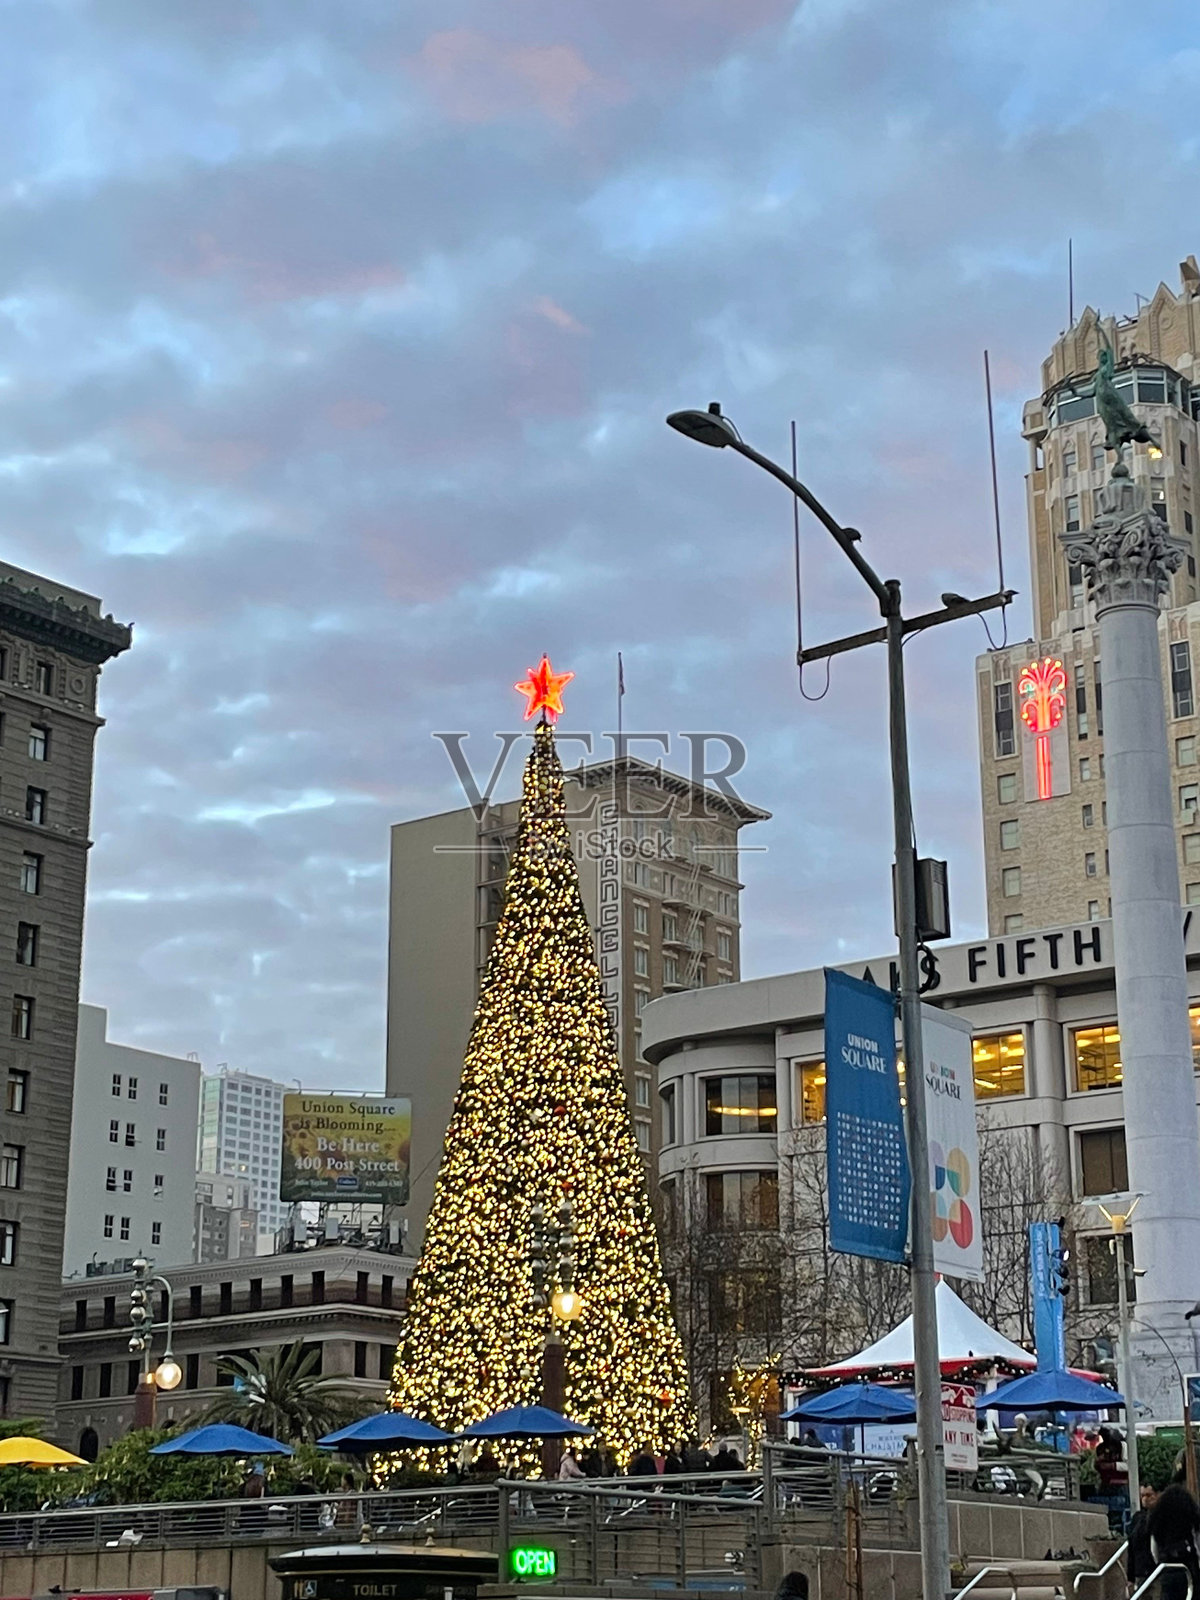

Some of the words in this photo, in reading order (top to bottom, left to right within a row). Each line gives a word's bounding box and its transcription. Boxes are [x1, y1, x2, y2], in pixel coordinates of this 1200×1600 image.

[968, 926, 1102, 983] FIFTH
[847, 1033, 879, 1053] UNION
[841, 1046, 888, 1075] SQUARE
[925, 1073, 962, 1101] SQUARE
[302, 1101, 344, 1114] Union
[349, 1102, 396, 1117] Square
[317, 1137, 337, 1152] Be
[341, 1137, 380, 1153] Here
[295, 1156, 321, 1170] 400
[327, 1157, 355, 1171] Post
[359, 1158, 400, 1172] Street
[944, 1429, 957, 1445] ANY
[960, 1431, 975, 1447] TIME
[515, 1550, 556, 1575] OPEN
[353, 1584, 397, 1597] TOILET
